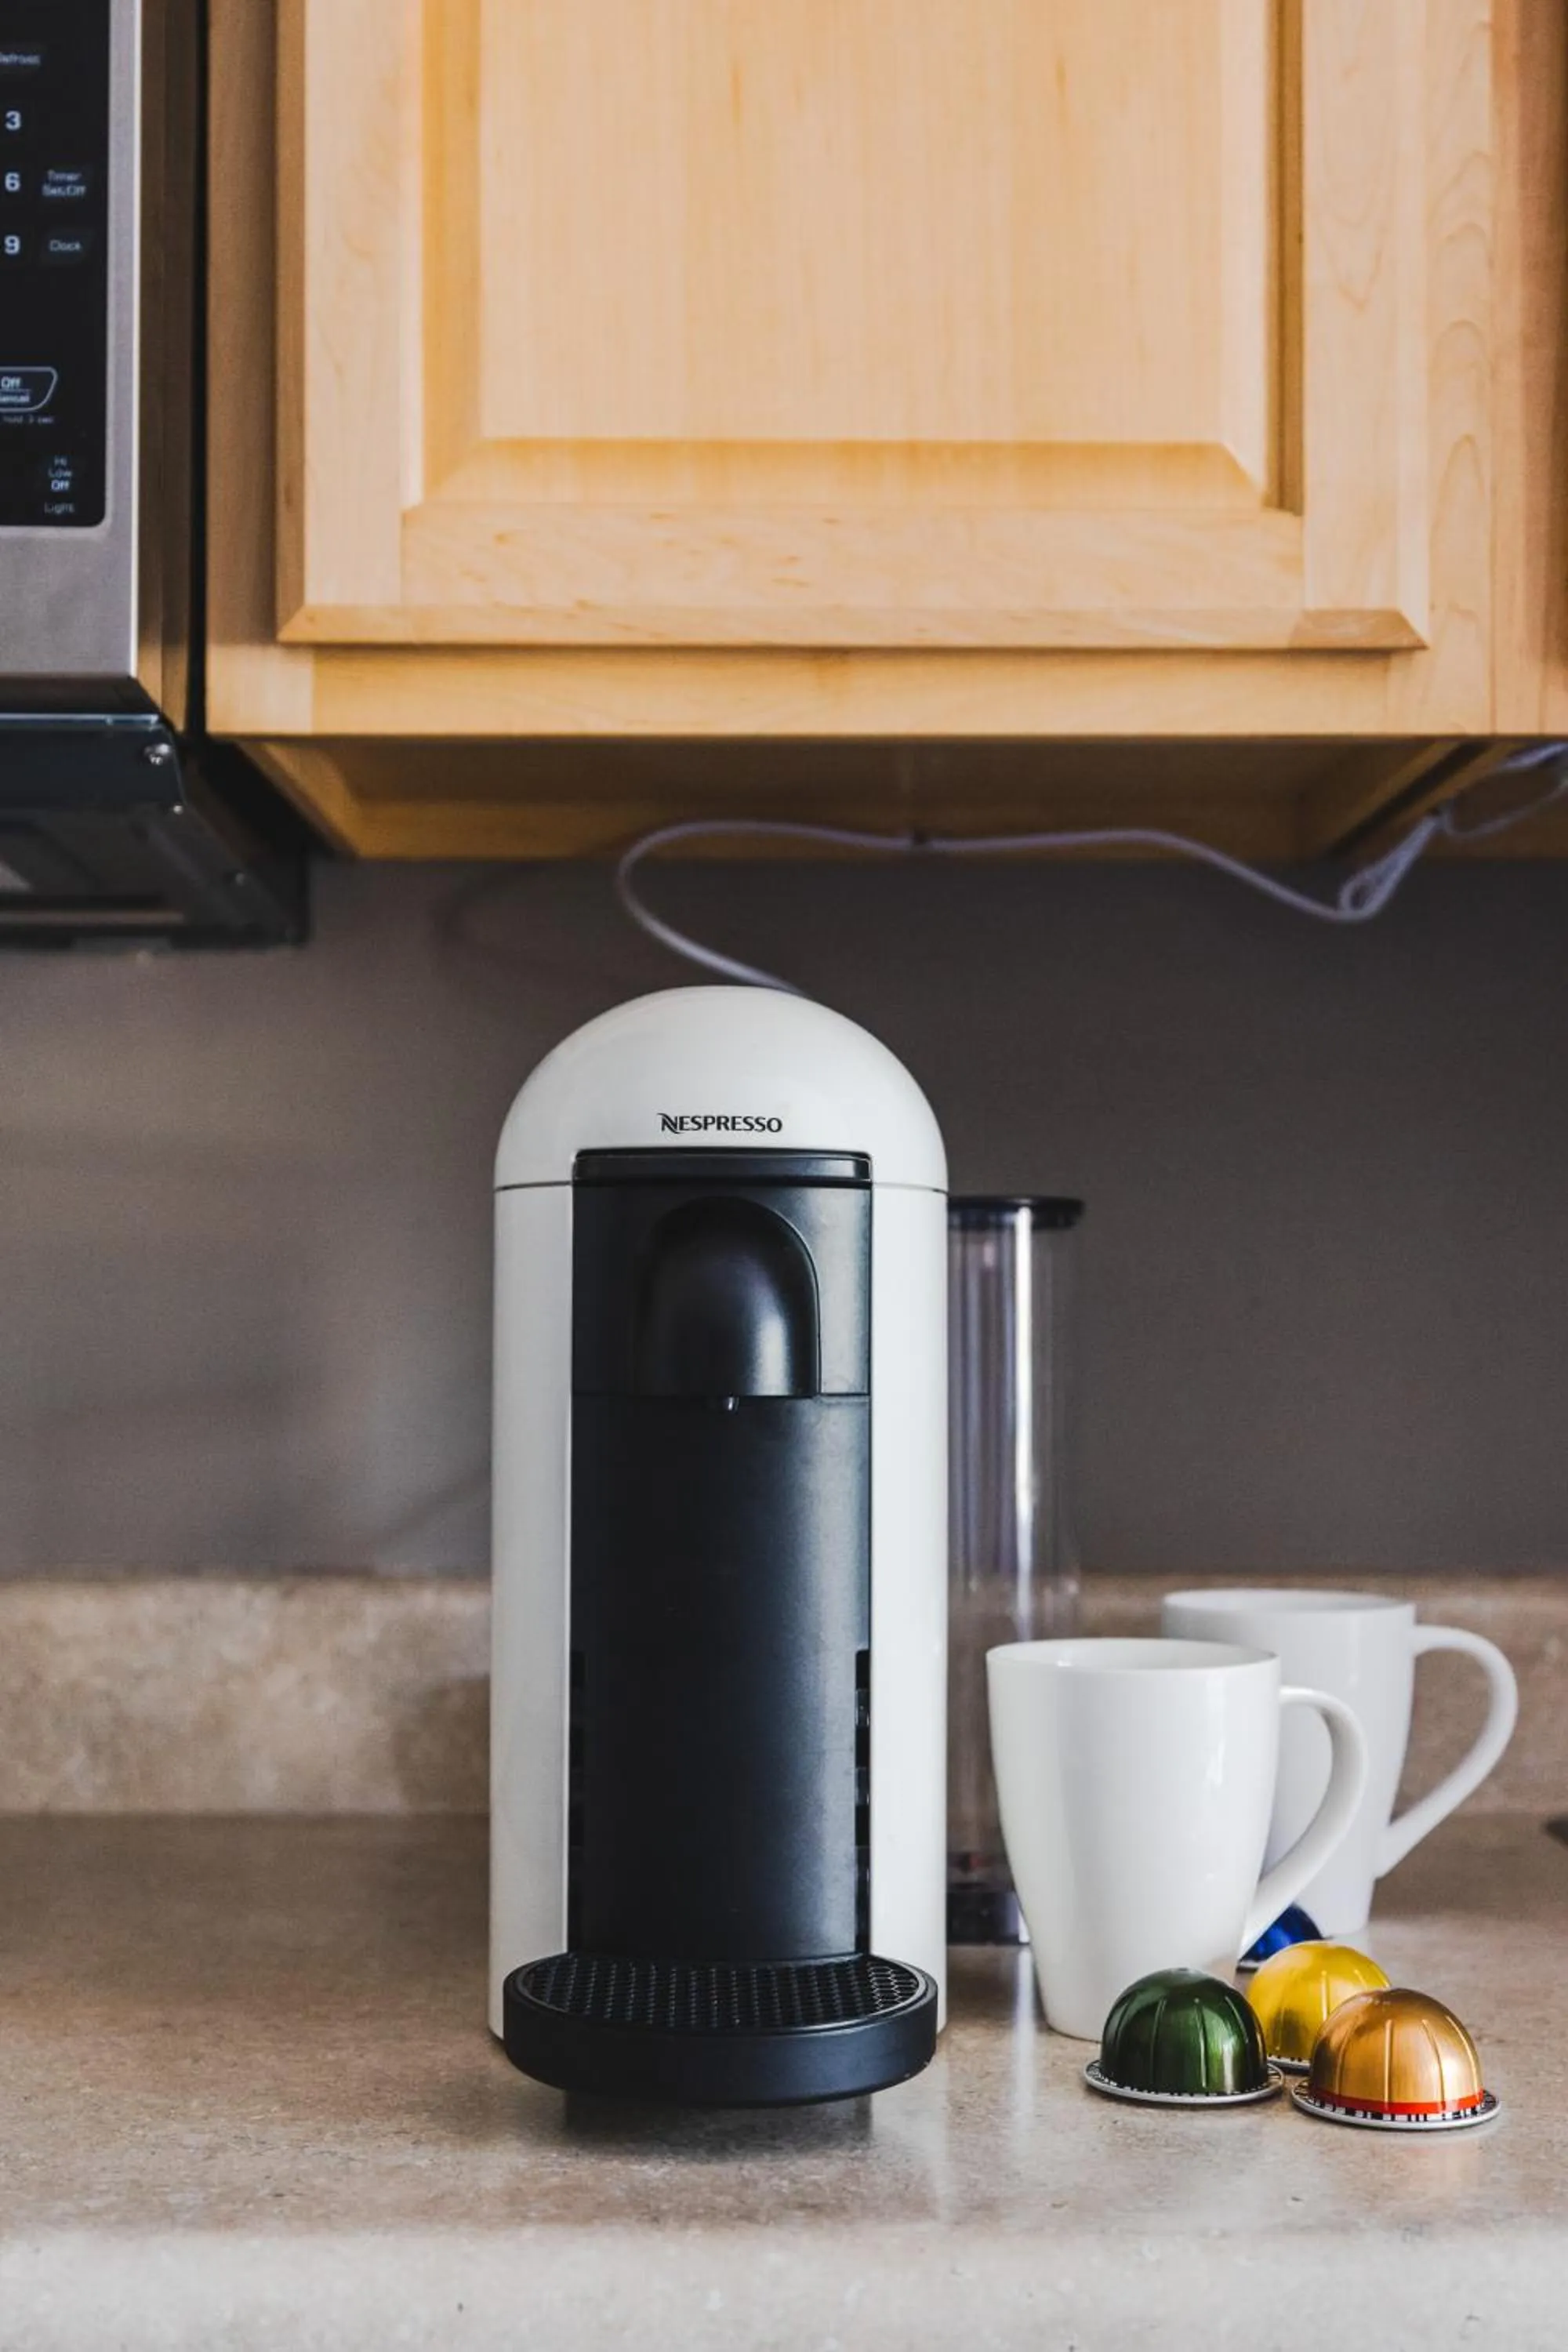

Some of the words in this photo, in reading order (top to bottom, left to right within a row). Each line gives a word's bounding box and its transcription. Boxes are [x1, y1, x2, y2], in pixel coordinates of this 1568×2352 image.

[5, 111, 21, 130] 3
[5, 172, 20, 191] 6
[4, 235, 20, 255] 9
[2, 376, 20, 388] Off
[51, 480, 70, 491] Off
[657, 1112, 782, 1134] NESPRESSO
